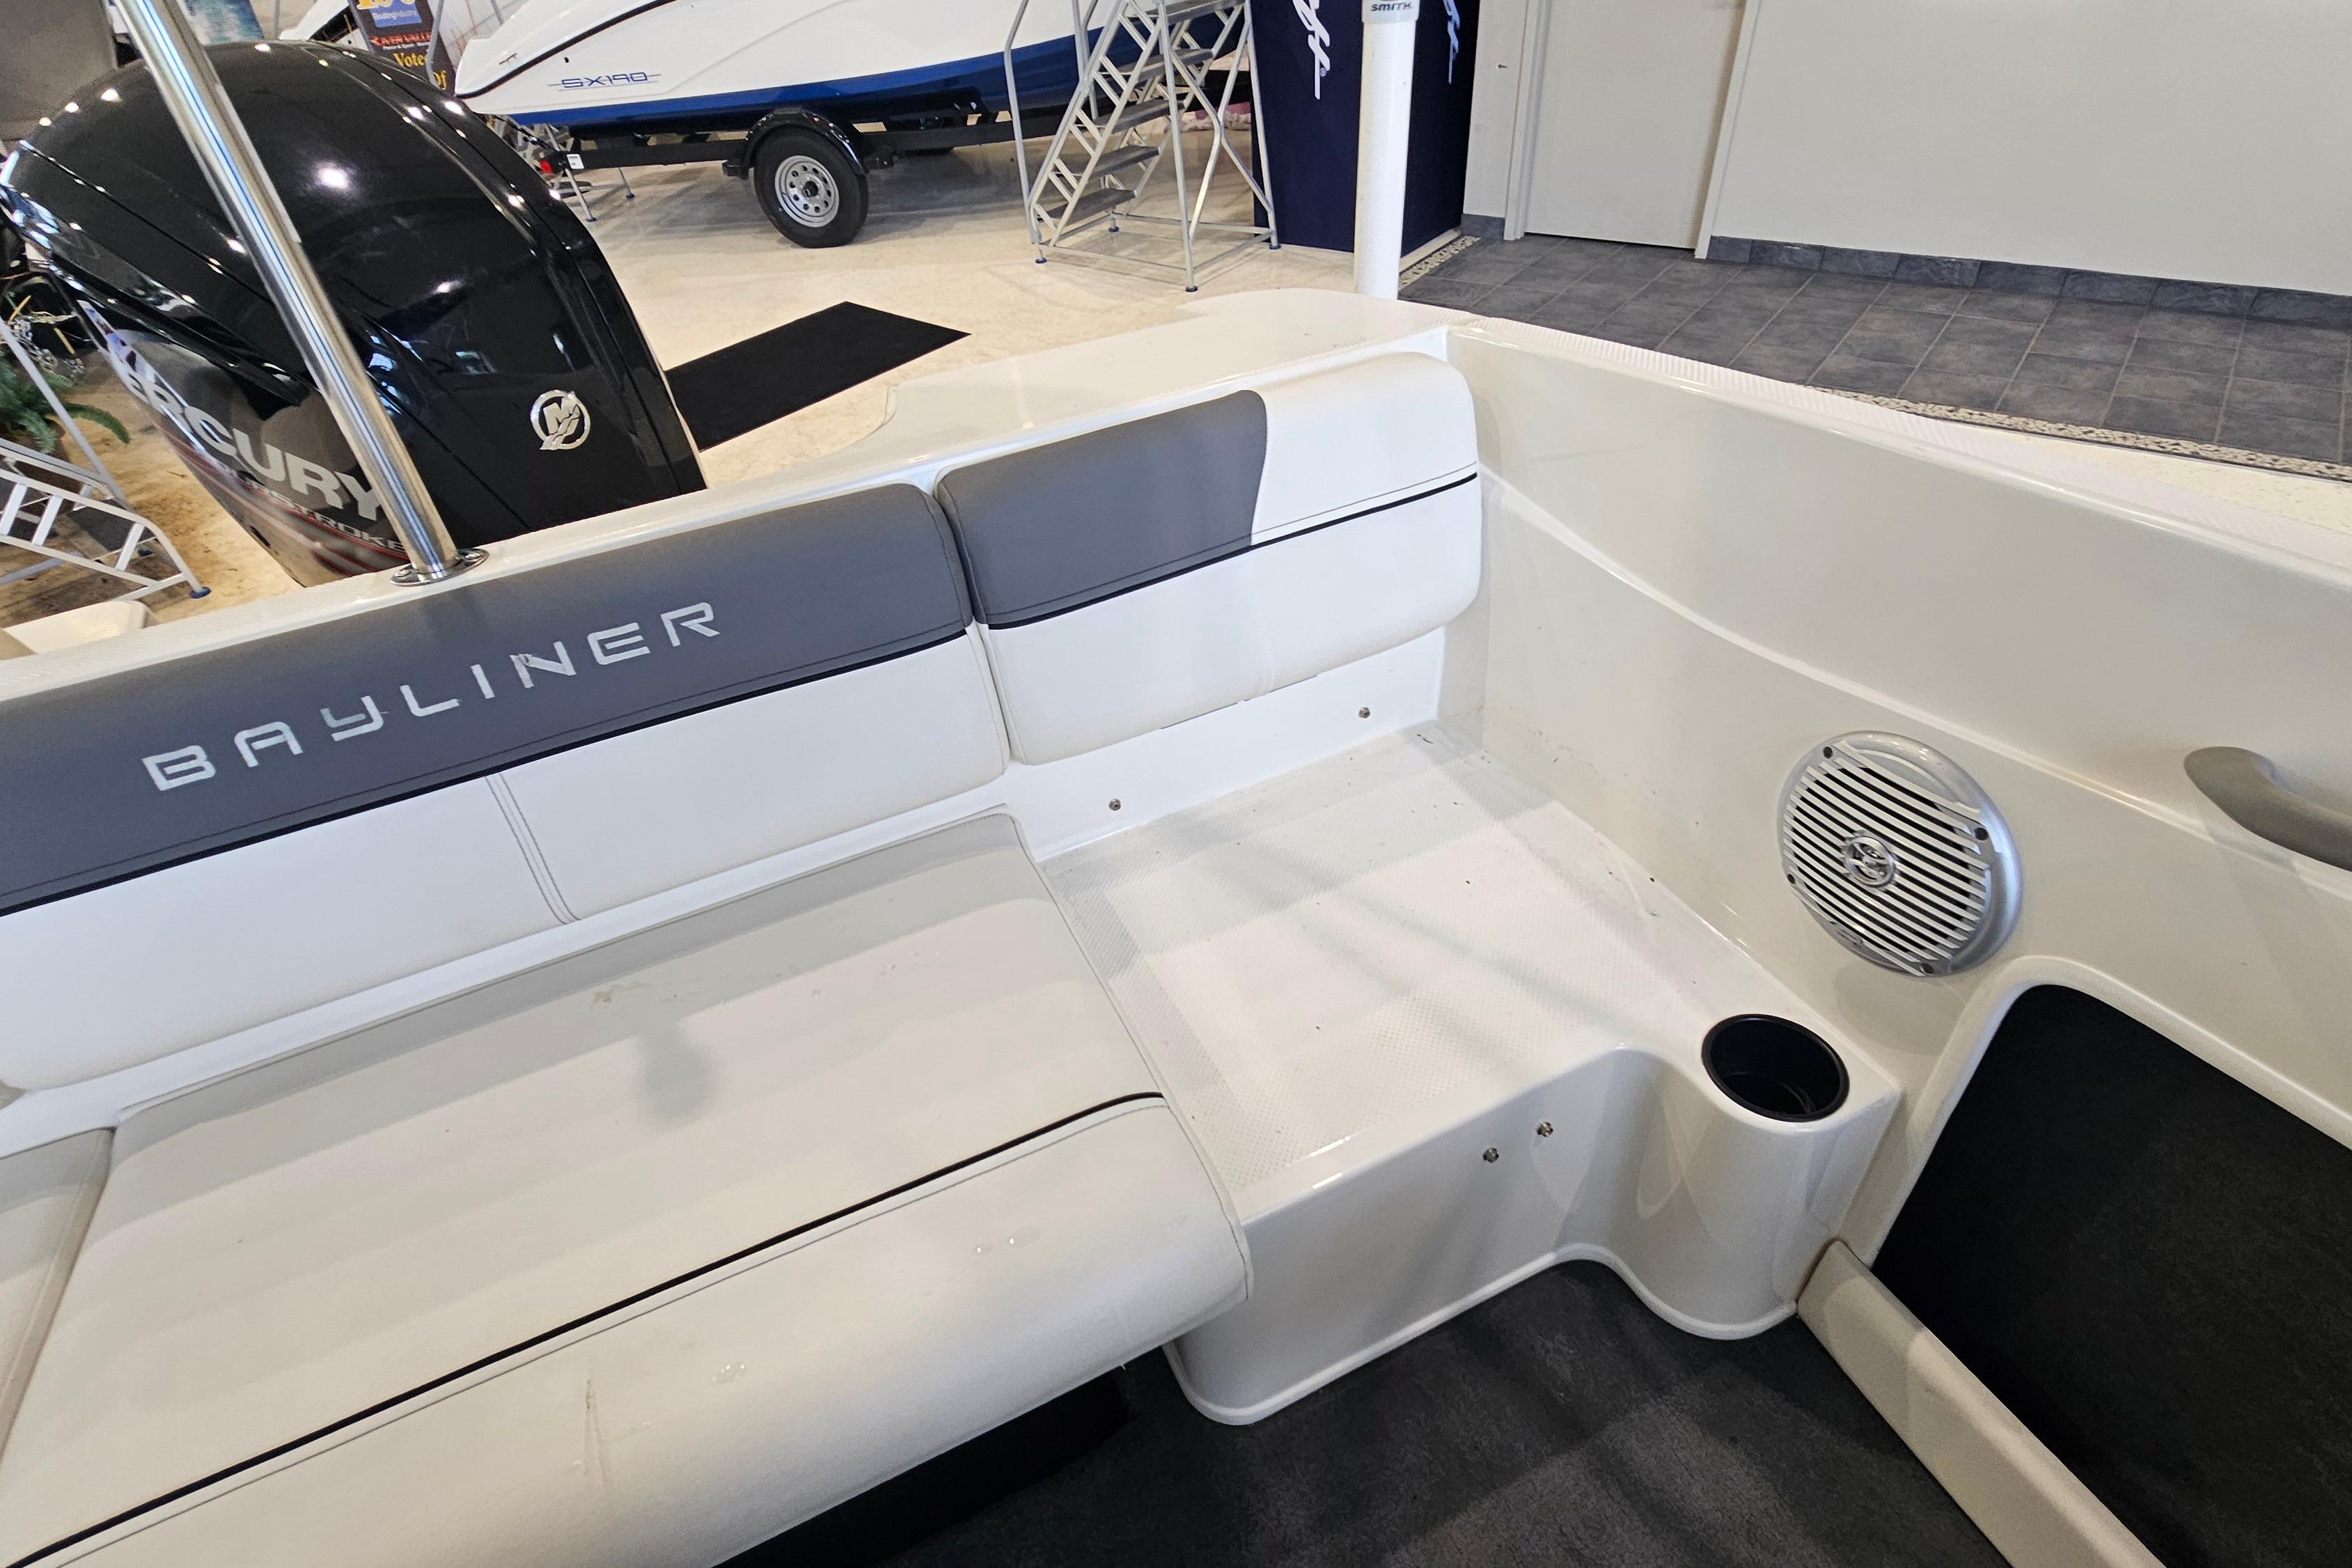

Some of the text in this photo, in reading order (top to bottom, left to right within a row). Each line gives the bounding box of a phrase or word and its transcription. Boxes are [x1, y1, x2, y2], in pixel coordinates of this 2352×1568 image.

[393, 52, 428, 67] Vote
[561, 72, 648, 88] SX190
[111, 352, 383, 522] ERCURY
[142, 602, 720, 792] BAYLINER
